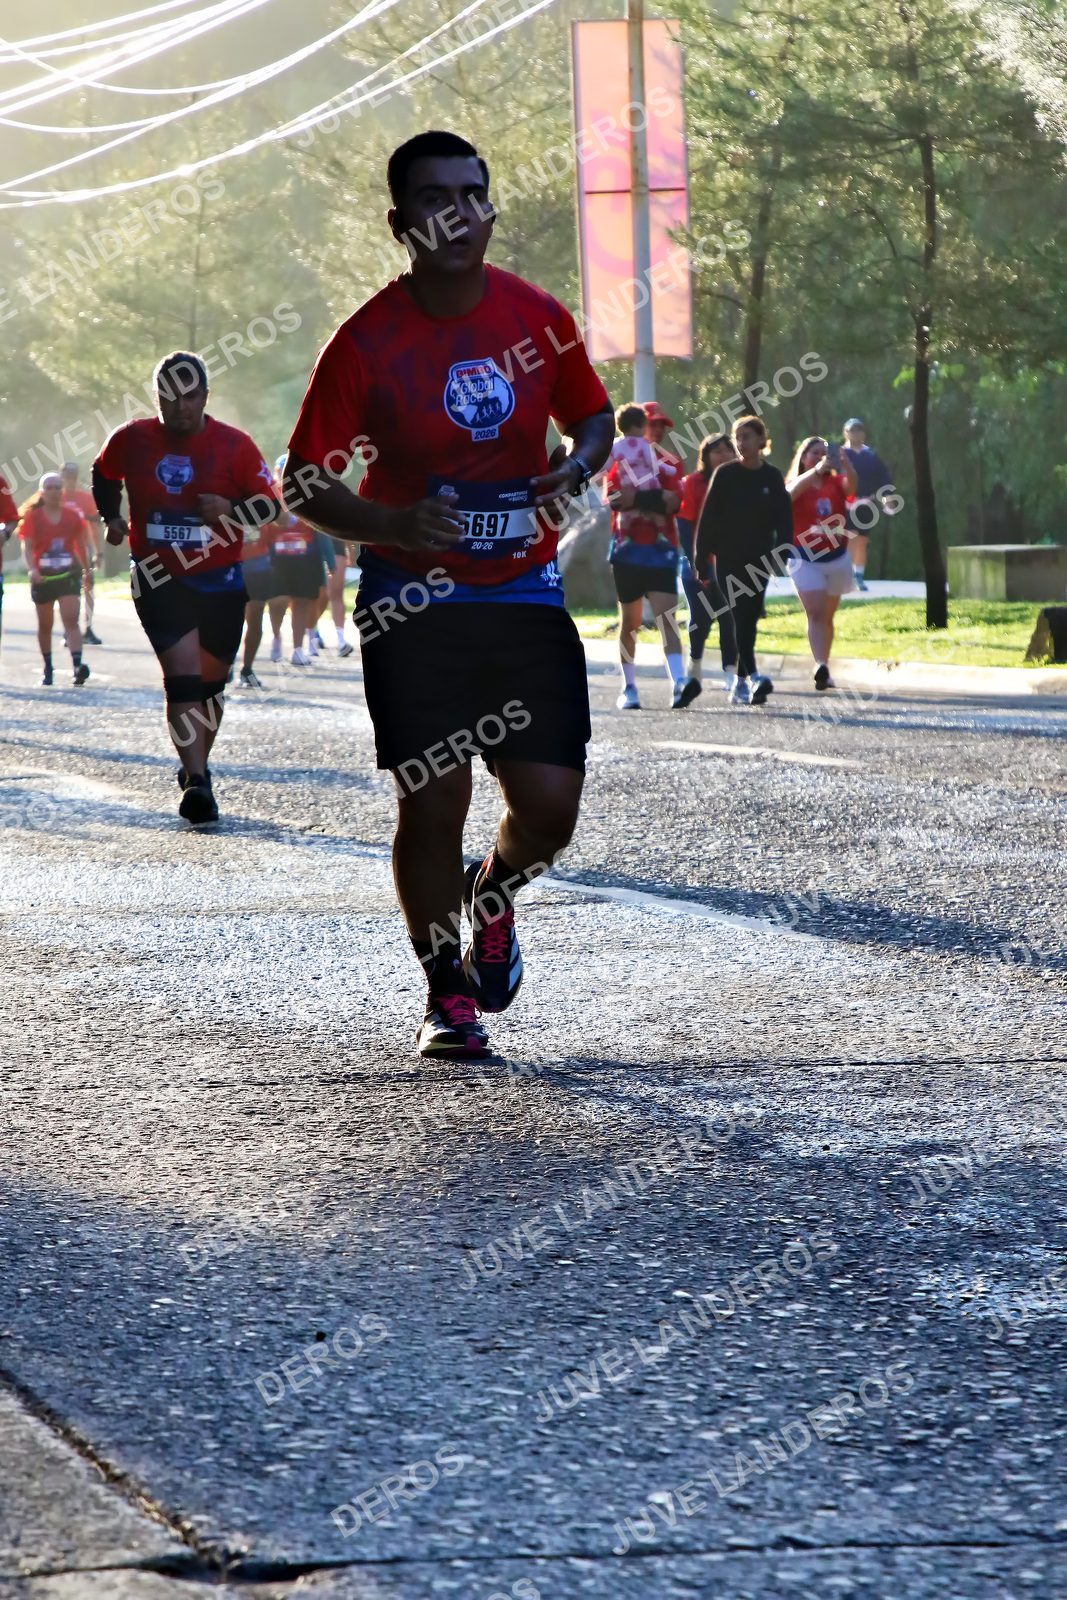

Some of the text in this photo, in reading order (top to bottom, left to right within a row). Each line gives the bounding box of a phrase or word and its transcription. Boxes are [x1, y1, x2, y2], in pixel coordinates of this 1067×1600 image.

[460, 377, 494, 395] Global
[455, 392, 484, 407] Race
[474, 428, 497, 440] 2026
[163, 526, 192, 539] 5567
[471, 541, 494, 550] 20-26
[512, 550, 527, 559] 10K
